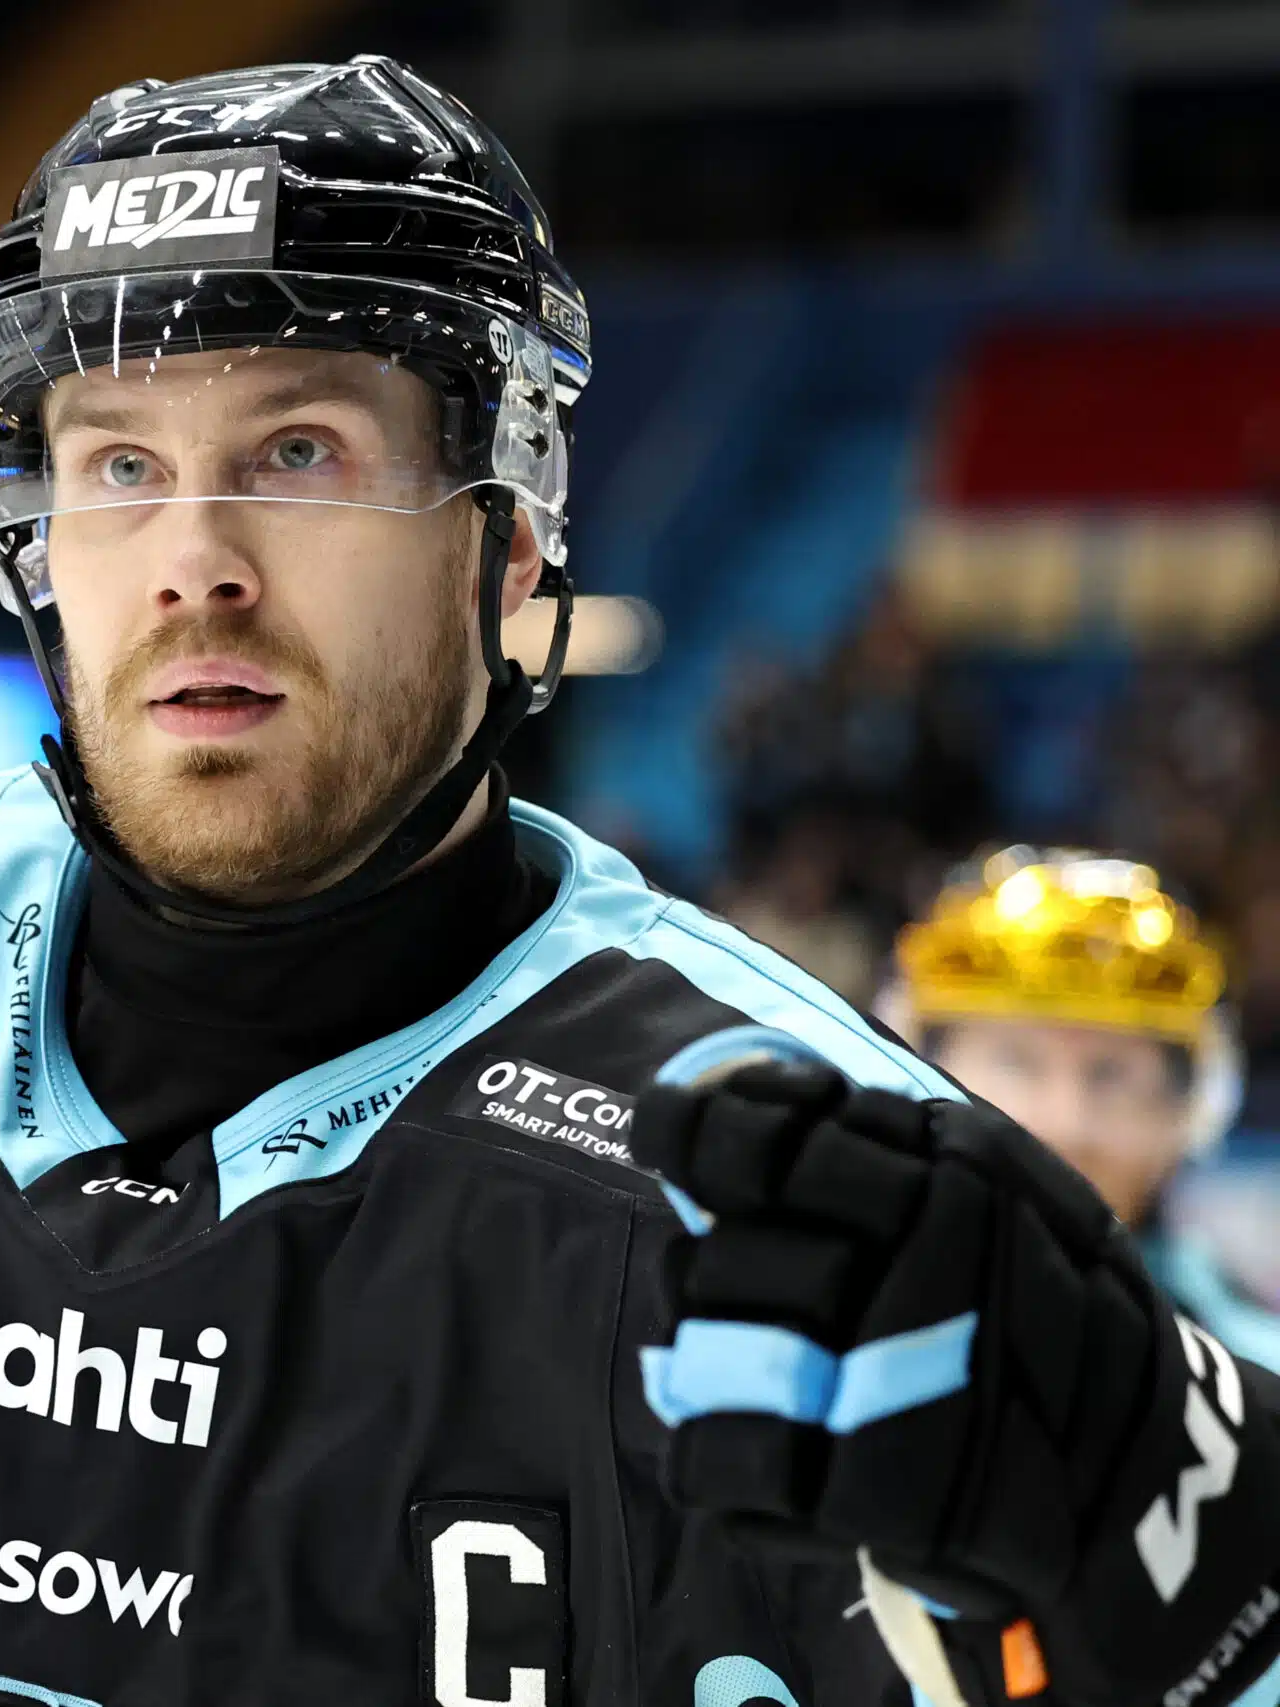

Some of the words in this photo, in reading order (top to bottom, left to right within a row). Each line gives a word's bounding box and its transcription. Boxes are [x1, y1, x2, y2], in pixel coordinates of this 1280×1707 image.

[54, 166, 266, 251] MEDIC
[482, 1101, 556, 1136] SMART
[431, 1520, 547, 1707] C
